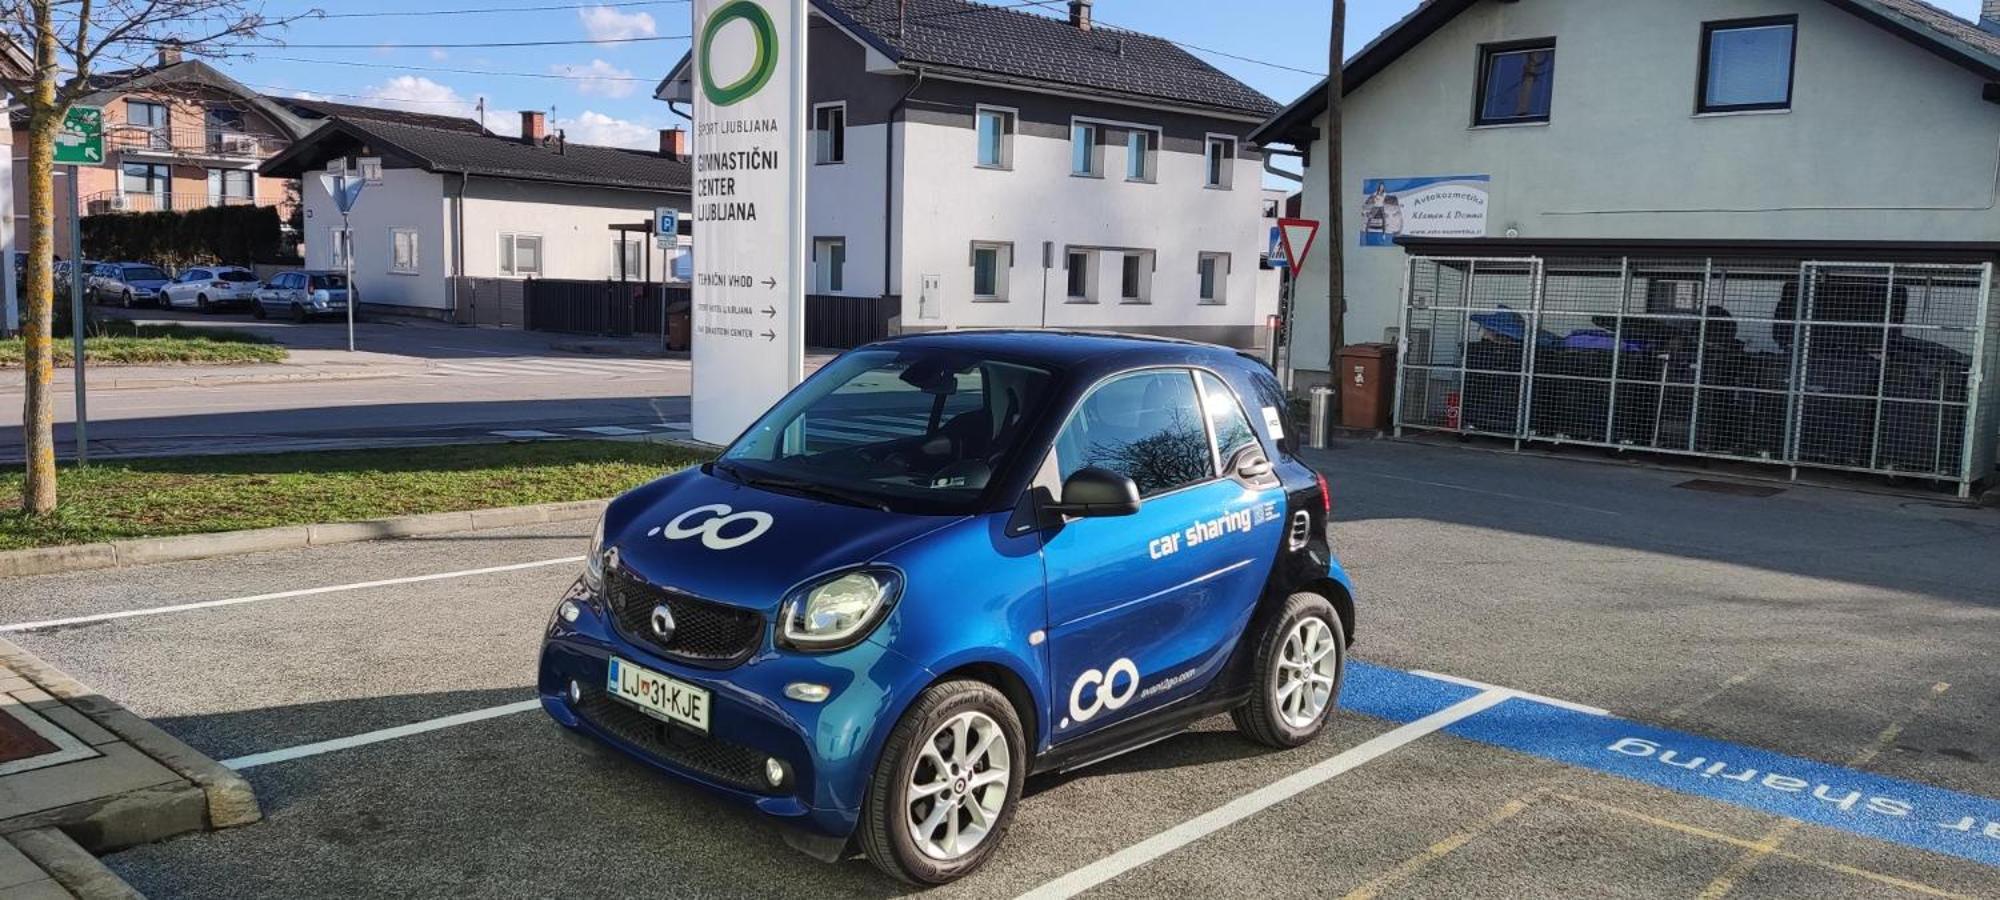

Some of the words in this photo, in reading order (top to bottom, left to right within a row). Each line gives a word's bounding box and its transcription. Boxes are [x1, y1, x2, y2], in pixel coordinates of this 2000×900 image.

[721, 119, 778, 134] LJUBLJANA
[697, 146, 778, 172] GIMNASTIČNI
[697, 177, 736, 197] CENTER
[1413, 191, 1484, 207] Avtokozmetika
[697, 202, 757, 222] LJUBLJANA
[728, 274, 753, 288] VHOD
[1149, 532, 1182, 560] car
[1185, 507, 1251, 547] sharing
[622, 668, 640, 698] LJ
[651, 679, 702, 723] 31-KJE
[1607, 737, 1913, 816] sharing
